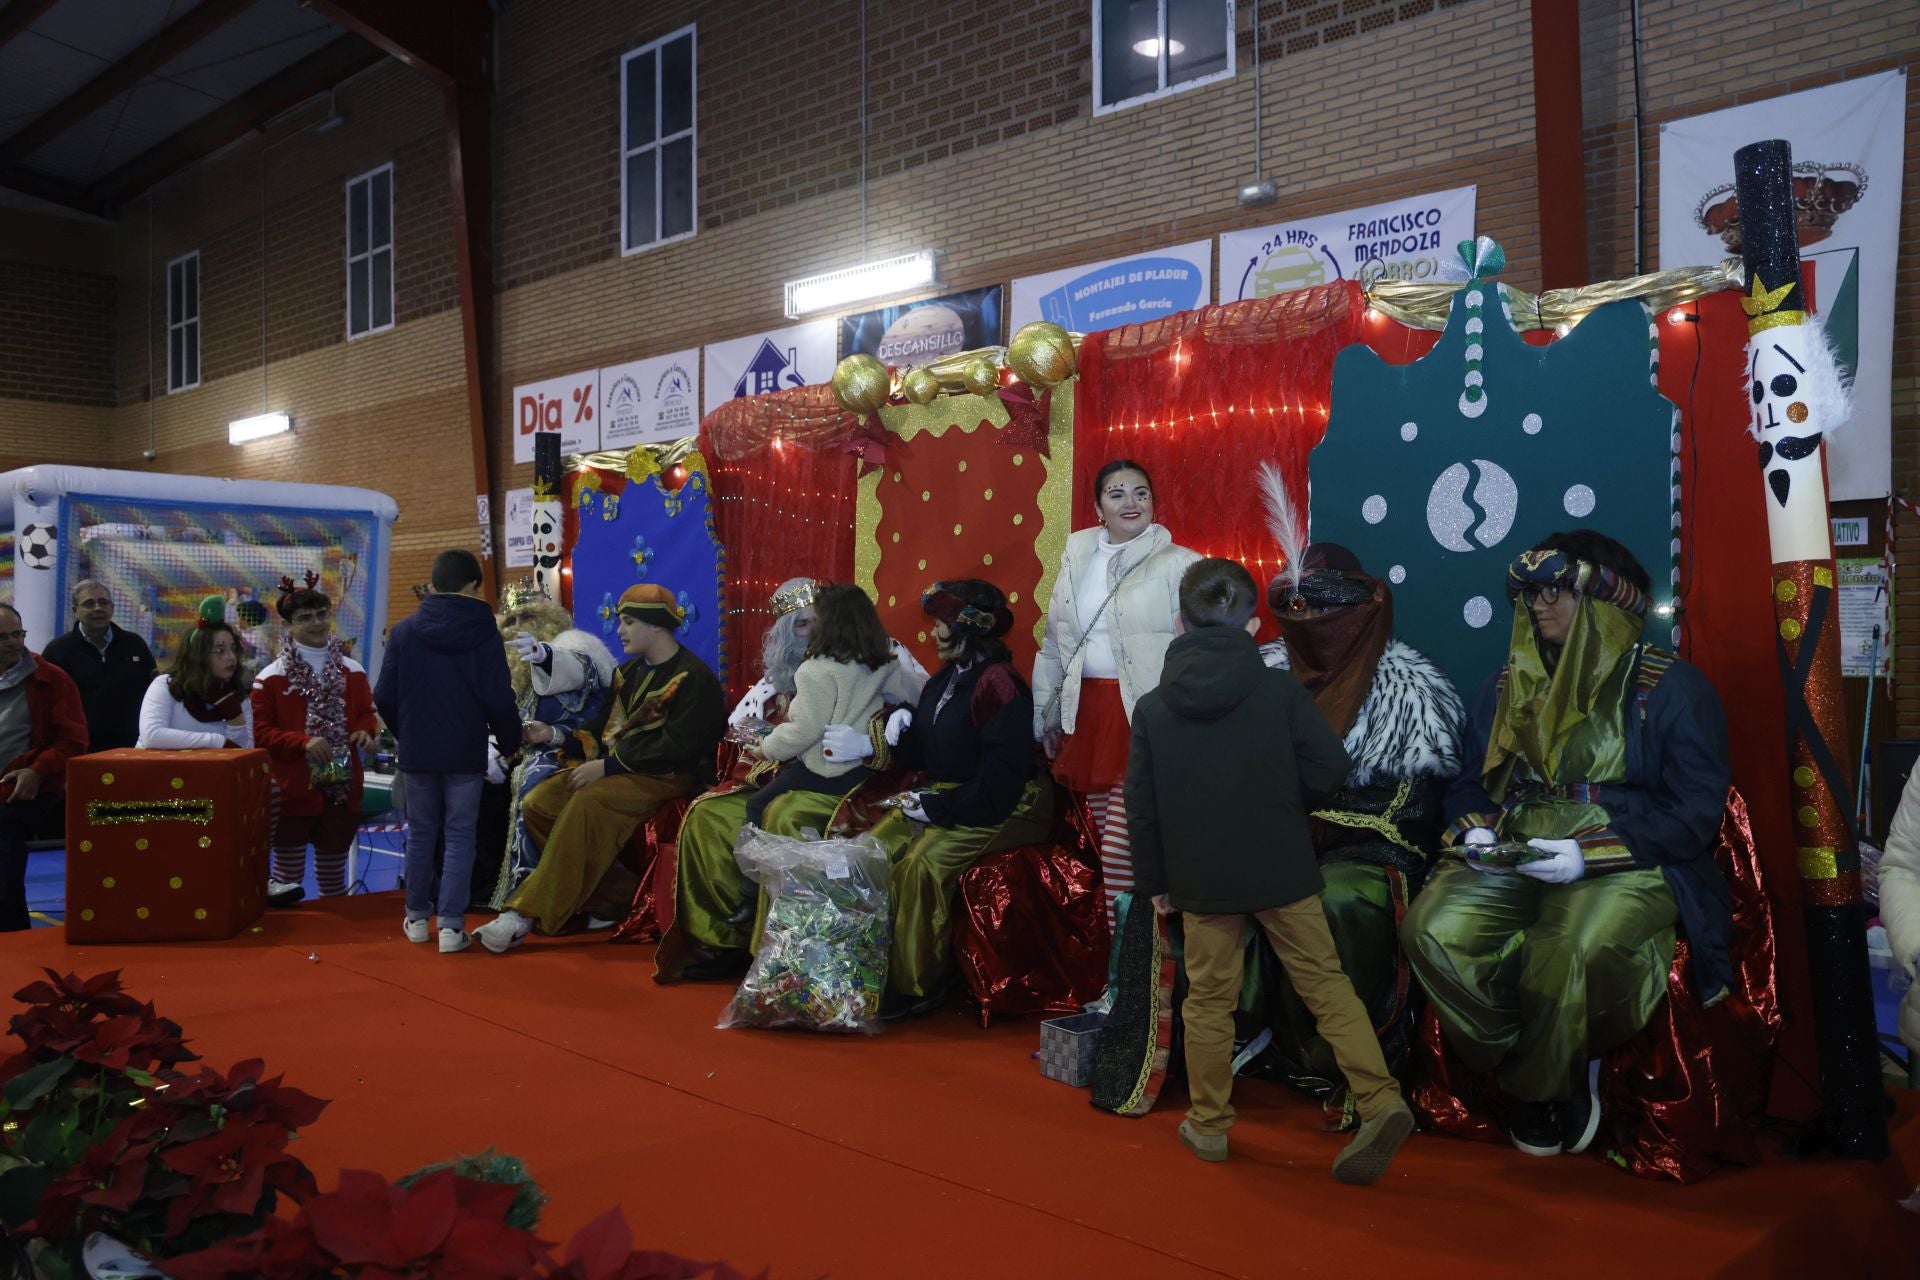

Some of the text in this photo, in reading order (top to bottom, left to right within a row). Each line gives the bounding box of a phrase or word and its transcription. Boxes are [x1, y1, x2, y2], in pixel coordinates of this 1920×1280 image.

[1348, 208, 1442, 241] FRANCISCO
[1262, 229, 1318, 256] 24 HRS
[1355, 230, 1441, 263] MENDOZA
[1074, 269, 1189, 302] MONTAJES DE PLADUR
[1089, 298, 1172, 322] Fernando García
[879, 331, 963, 359] DESCANSILLO
[520, 393, 562, 435] Dia
